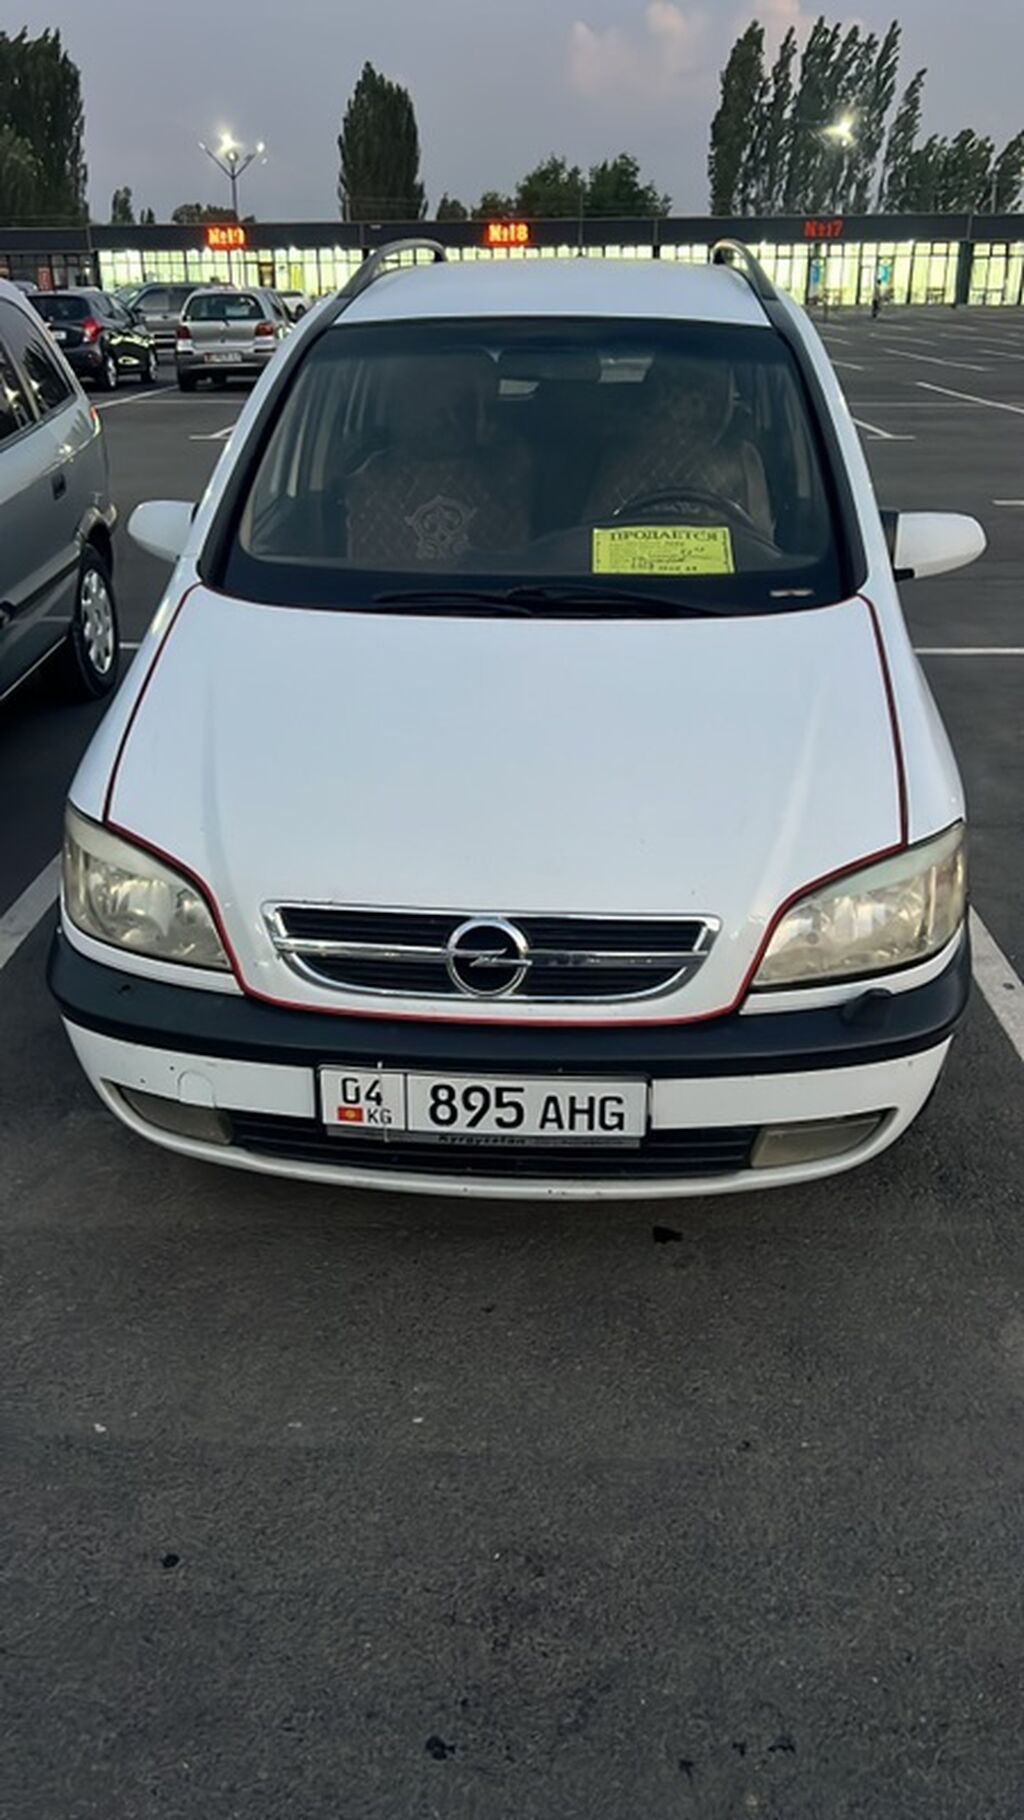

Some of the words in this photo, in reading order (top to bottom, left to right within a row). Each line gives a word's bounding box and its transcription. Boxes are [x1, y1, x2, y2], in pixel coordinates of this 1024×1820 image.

[610, 529, 718, 542] ПРОДАЕТСЯ
[341, 1077, 384, 1107] 04
[429, 1084, 525, 1130] 895
[539, 1096, 625, 1131] AHG
[367, 1108, 393, 1125] KG
